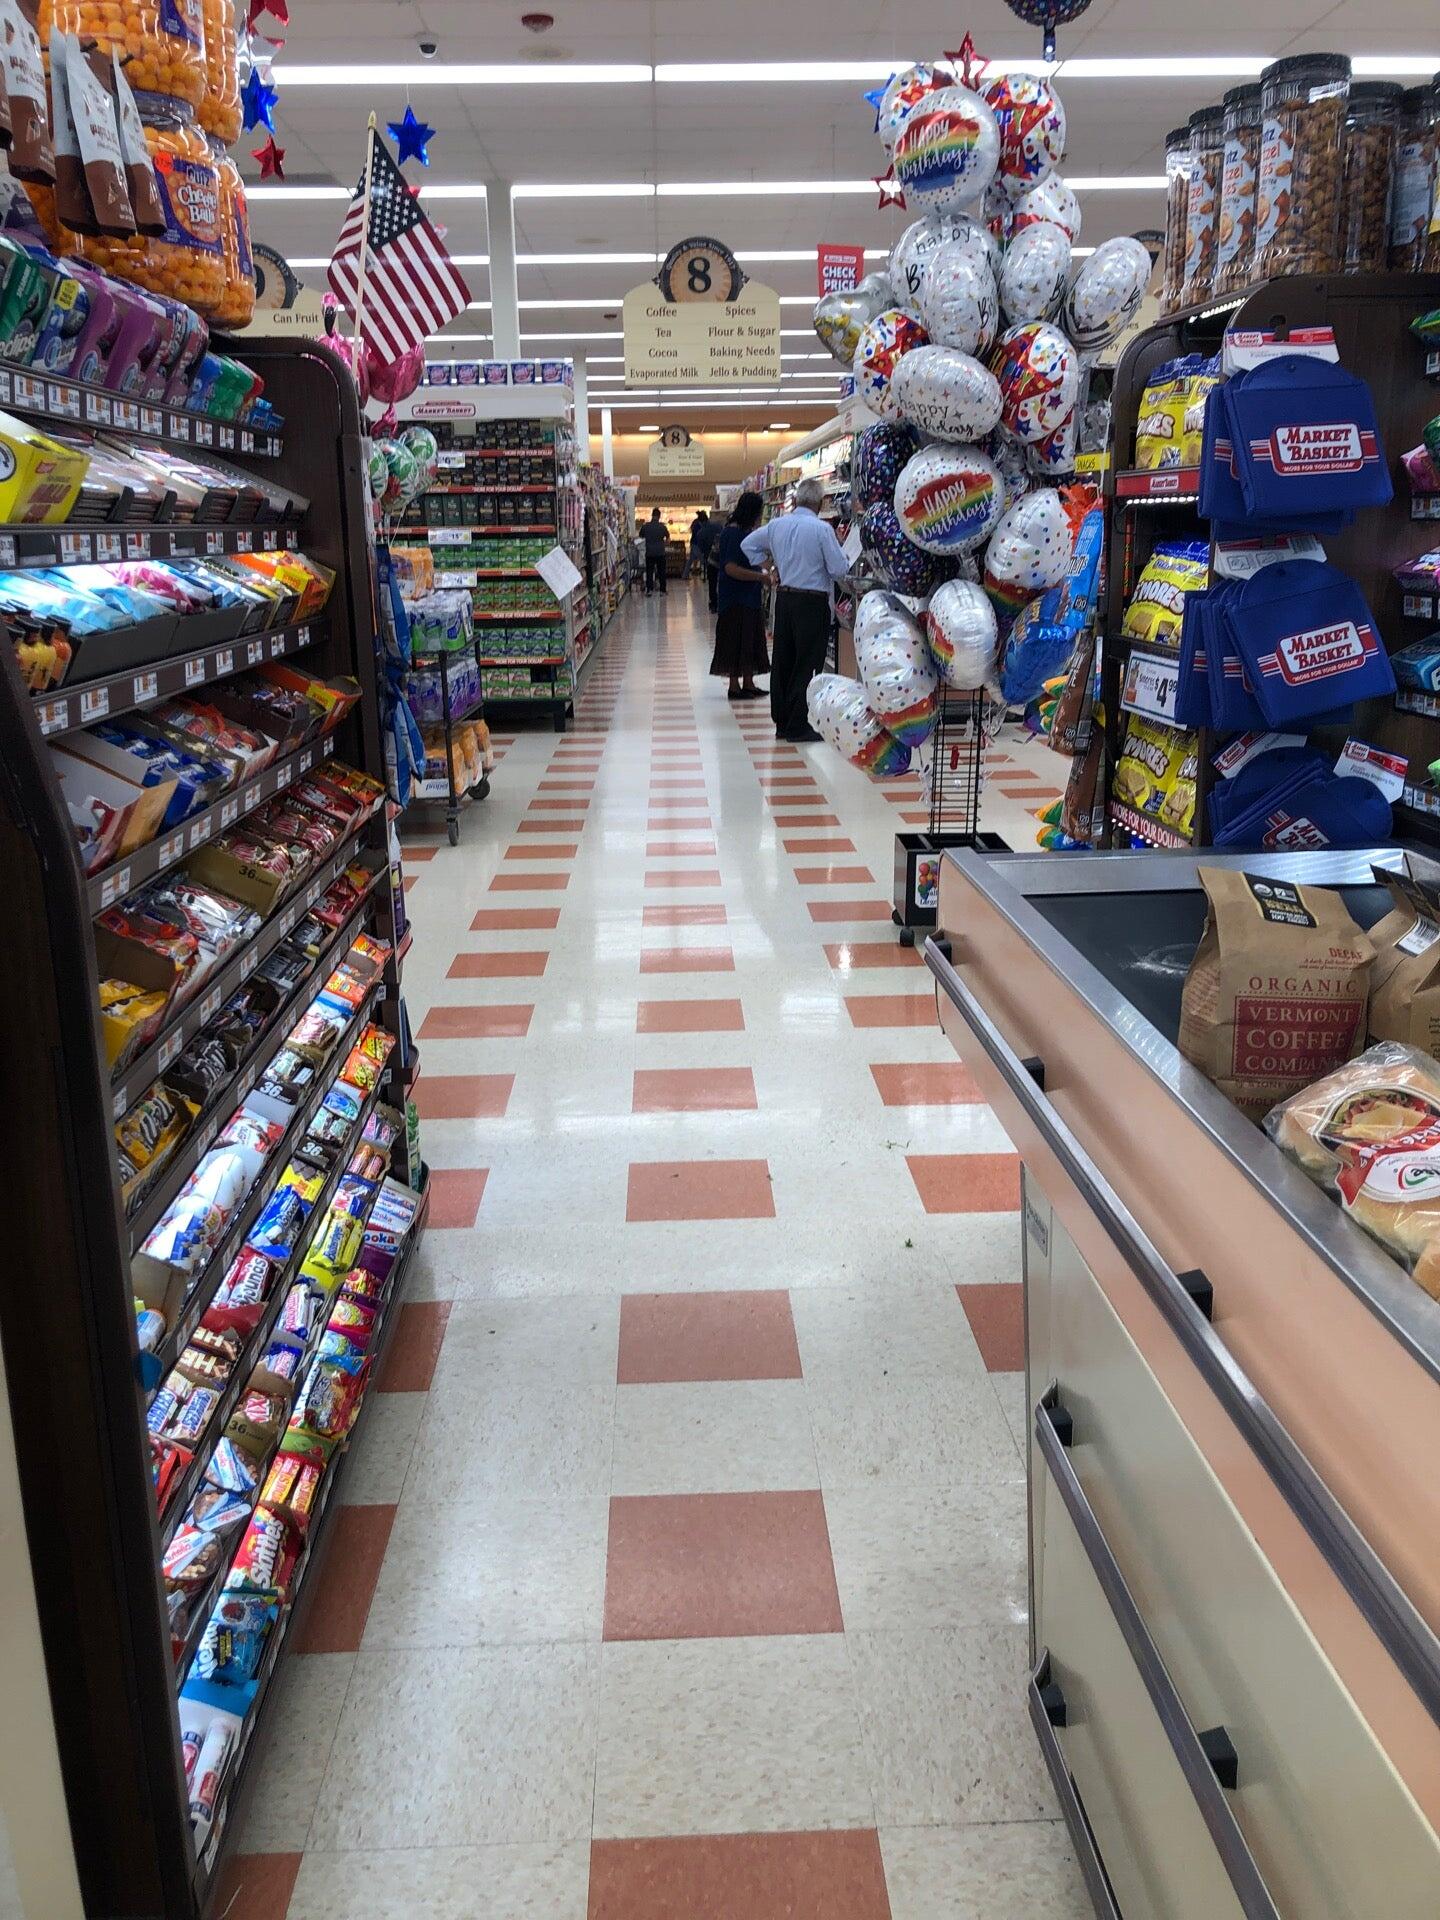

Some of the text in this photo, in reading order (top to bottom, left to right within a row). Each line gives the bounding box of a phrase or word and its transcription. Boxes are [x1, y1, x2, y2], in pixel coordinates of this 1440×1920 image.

[915, 226, 971, 255] hapy
[688, 256, 712, 293] 8
[823, 266, 856, 279] CHECK
[823, 279, 856, 292] PRICE
[273, 313, 319, 324] Can Fruit
[646, 308, 677, 317] Coffee
[726, 306, 756, 318] Spices
[655, 328, 672, 338] Tea
[708, 326, 776, 338] Flour & Sugar
[648, 349, 678, 358] Cocoa
[710, 347, 776, 358] Baking Needs
[630, 367, 699, 381] Evaporated Milk
[709, 366, 778, 378] Jello & Pudding
[672, 432, 680, 445] 8
[1282, 427, 1352, 445] MARKET
[1287, 445, 1351, 461] BASKET
[920, 490, 991, 540] Birthday!
[1288, 626, 1350, 655] MARKET
[1294, 643, 1353, 669] BASKET
[286, 797, 312, 816] KING
[1129, 810, 1140, 831] FOR
[1140, 817, 1158, 839] YOUR
[238, 865, 256, 879] 36
[1329, 947, 1363, 960] DECAF
[1249, 977, 1359, 993] ORGANIC
[1250, 1006, 1353, 1022] VERMONT
[1247, 1028, 1348, 1050] COFFEE
[260, 1081, 283, 1098] 36
[302, 1142, 323, 1157] 36
[229, 1419, 248, 1434] 36
